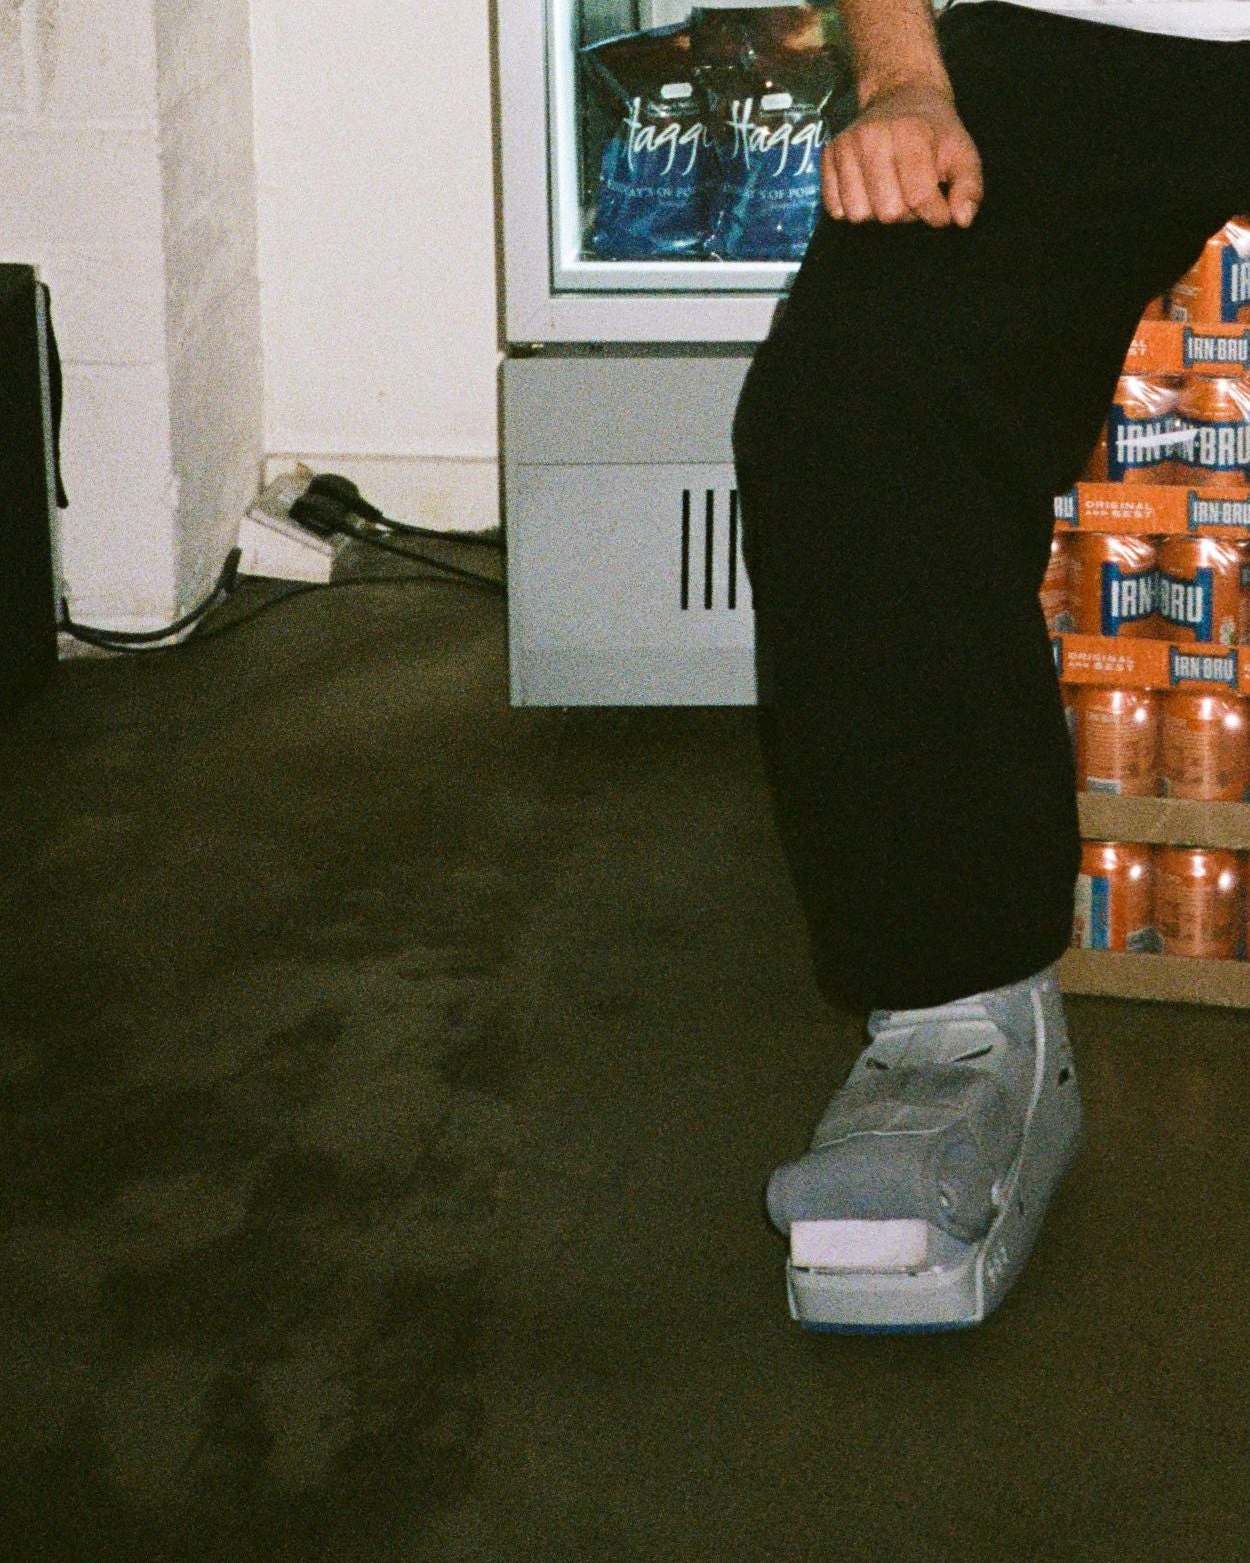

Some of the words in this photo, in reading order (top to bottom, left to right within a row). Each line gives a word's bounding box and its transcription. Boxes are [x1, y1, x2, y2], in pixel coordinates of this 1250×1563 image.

[1187, 336, 1249, 361] IRN-BRU
[1085, 499, 1153, 510] ORIGINAL
[1112, 510, 1153, 519] BEST
[1067, 652, 1135, 664] ORIGINAL
[1093, 662, 1135, 672] BEST
[1174, 655, 1235, 680] IRN-BRU
